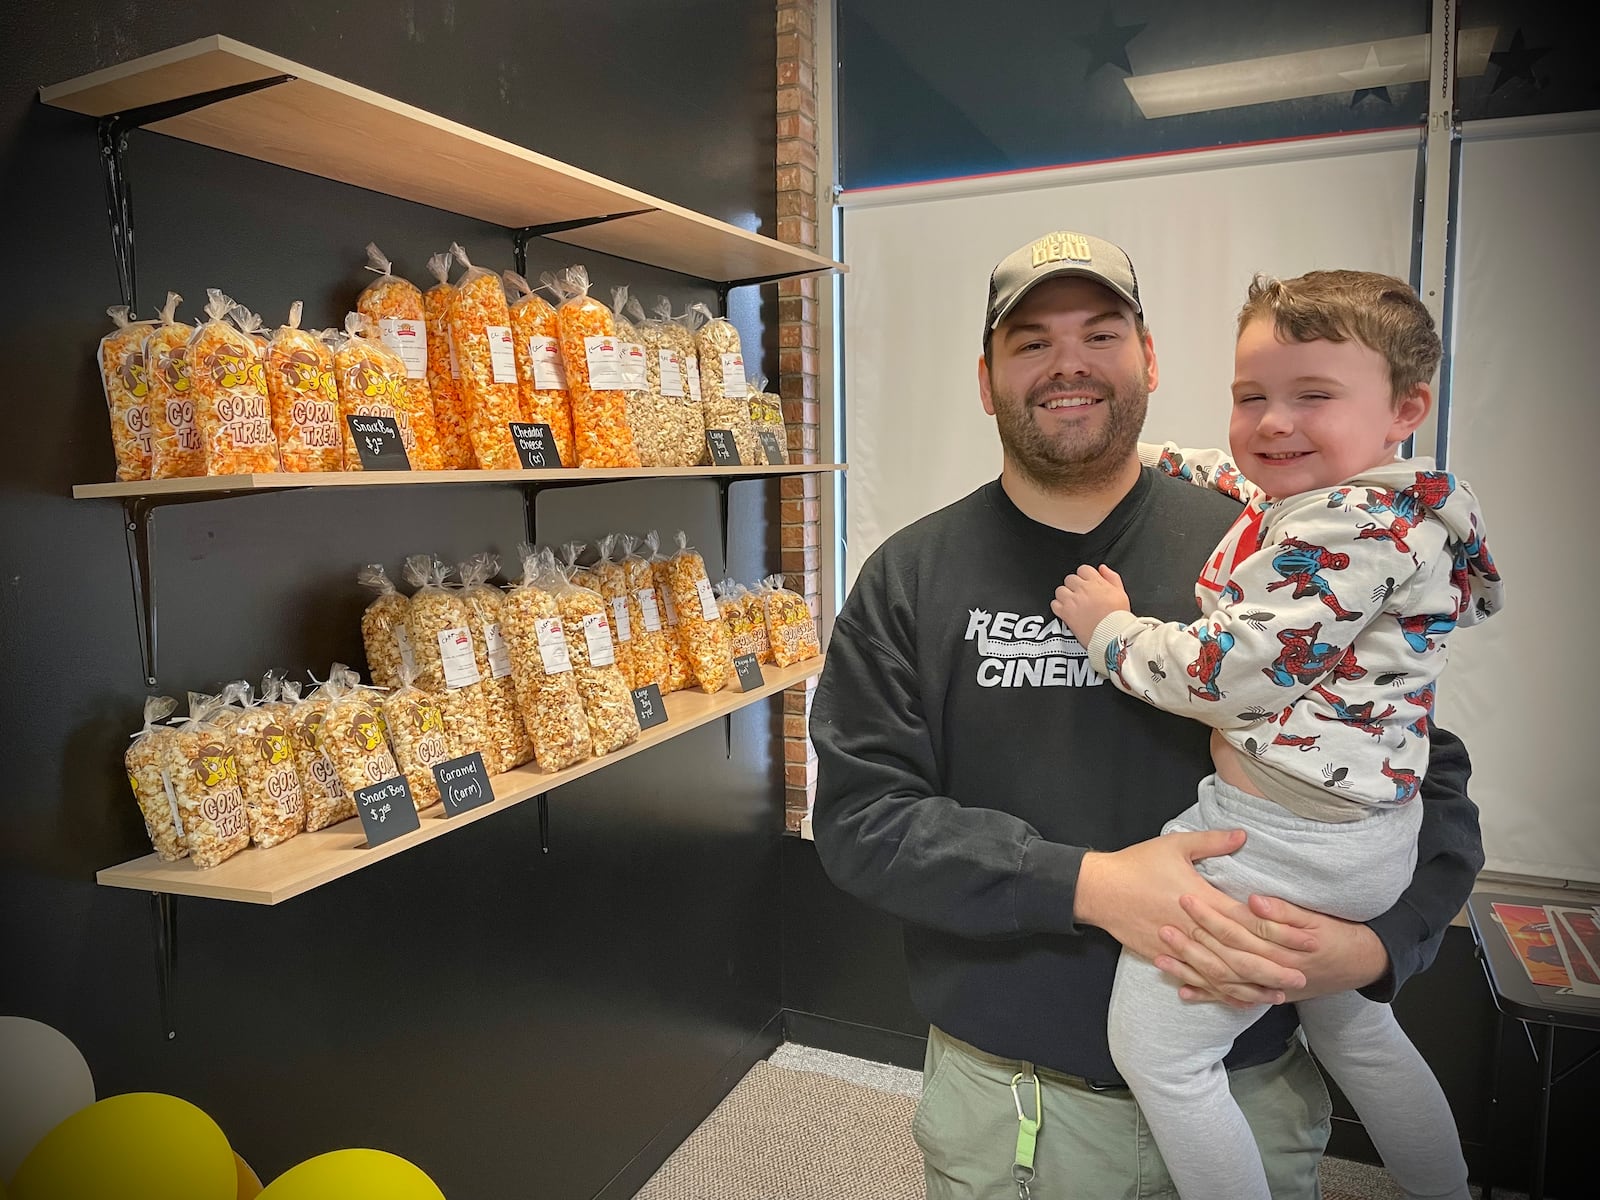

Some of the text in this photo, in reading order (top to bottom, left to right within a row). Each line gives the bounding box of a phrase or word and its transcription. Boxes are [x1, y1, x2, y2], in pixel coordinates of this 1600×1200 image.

[1032, 242, 1092, 268] DEAD
[168, 401, 194, 427] CO
[217, 396, 265, 422] CORN
[293, 401, 334, 425] CORN
[353, 419, 381, 433] Snack
[377, 419, 396, 439] Bag
[513, 425, 544, 438] Cheddar
[519, 438, 545, 450] Cheese
[312, 757, 335, 783] CO
[440, 761, 478, 784] Caramel
[204, 787, 243, 821] CORN
[360, 783, 406, 806] Snack Bag
[448, 778, 483, 807] (Carm)
